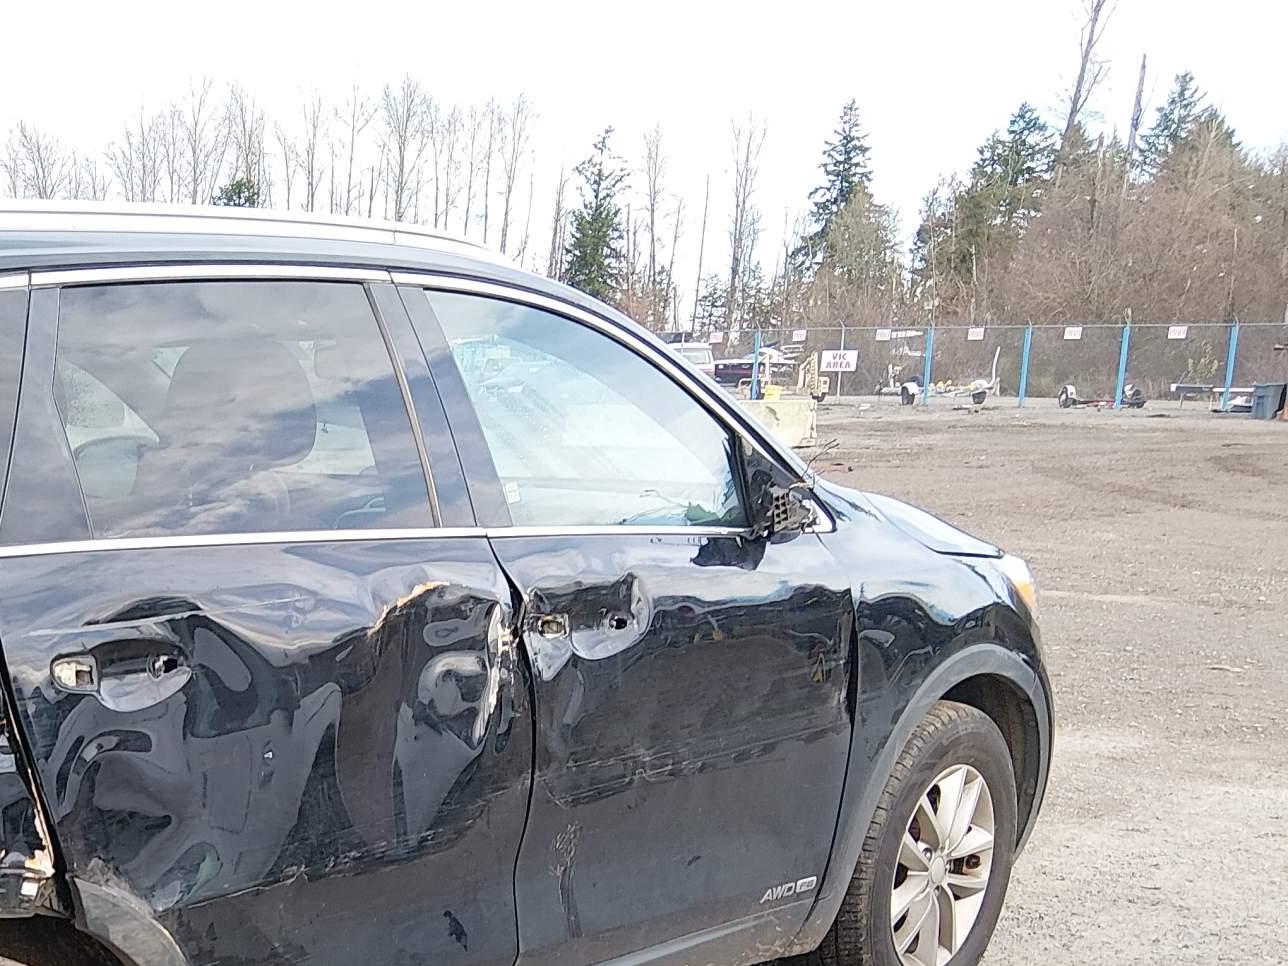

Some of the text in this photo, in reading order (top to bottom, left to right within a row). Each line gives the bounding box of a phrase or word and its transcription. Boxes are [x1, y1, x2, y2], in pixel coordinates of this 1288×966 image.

[832, 352, 848, 361] VIC
[825, 361, 851, 369] AREA
[759, 882, 795, 904] AWD
